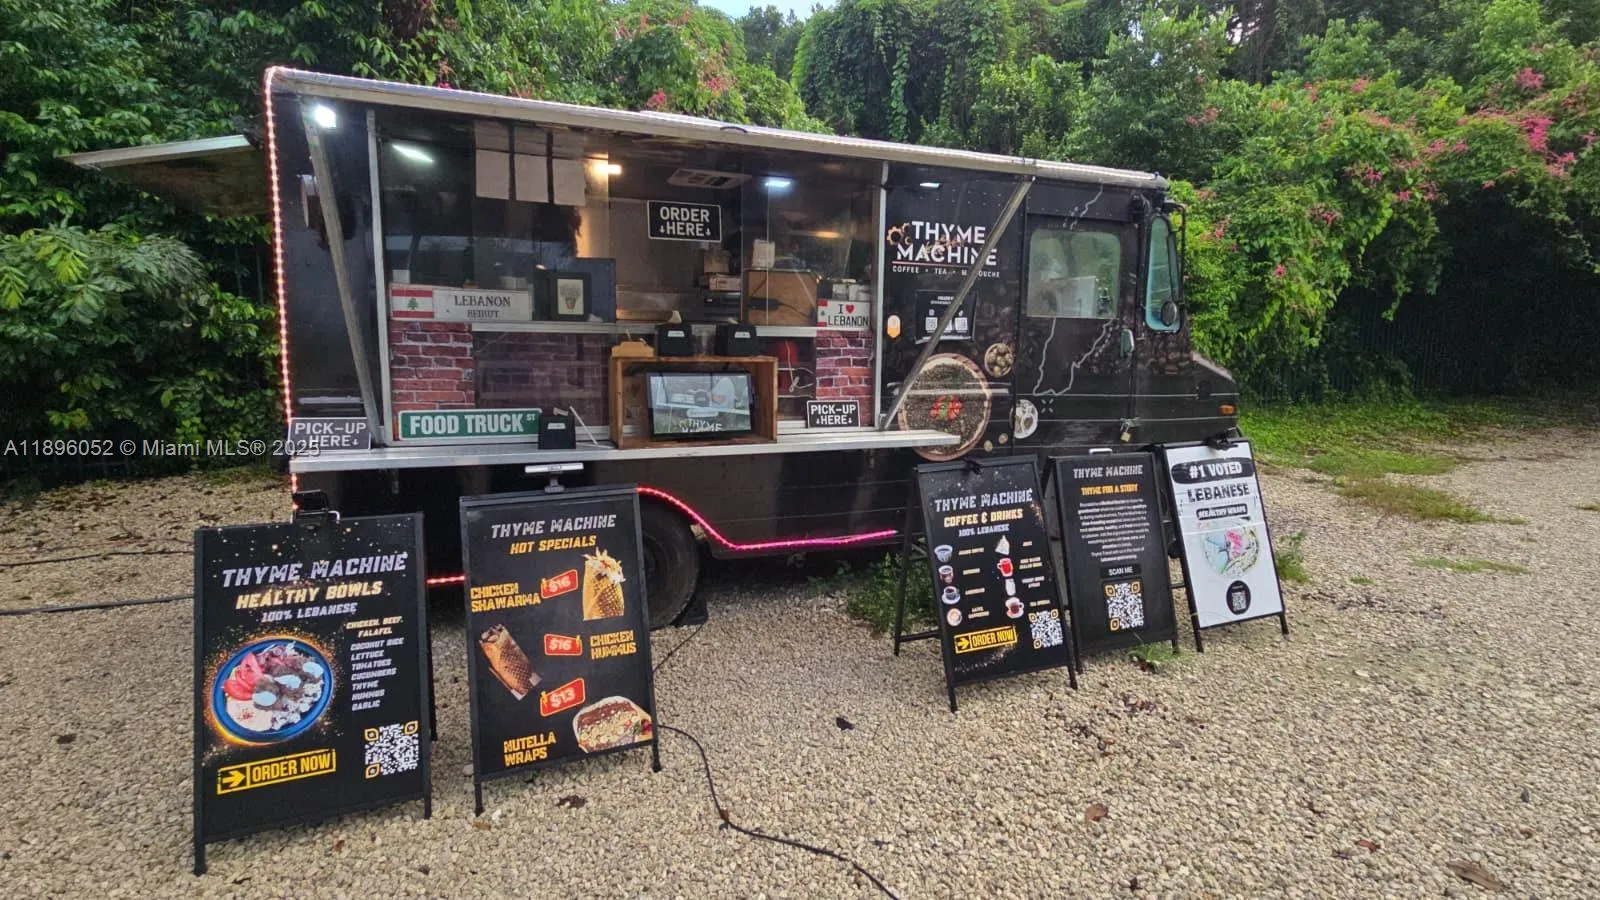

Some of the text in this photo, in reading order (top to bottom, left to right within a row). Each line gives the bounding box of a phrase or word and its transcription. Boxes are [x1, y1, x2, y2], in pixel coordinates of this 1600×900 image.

[660, 206, 710, 223] ORDER
[666, 220, 705, 236] HERE
[911, 221, 986, 244] THYME
[896, 243, 998, 266] MACHINE
[892, 265, 919, 274] COFFEE
[961, 270, 1000, 278] MOUCHE
[454, 294, 511, 307] LEBANON
[838, 303, 844, 314] I
[467, 309, 500, 319] BEIRUT
[828, 315, 869, 327] LEBANON
[810, 403, 857, 415] PICK-UP
[409, 412, 537, 436] FOOD TRUCK ST
[820, 414, 848, 425] HERE
[294, 422, 367, 435] PICK-UP
[308, 434, 352, 449] HERE
[1073, 464, 1144, 479] THYME MACHINE
[1189, 461, 1243, 479] #1 VOTED
[1114, 485, 1120, 493] A
[1187, 483, 1251, 503] LEBANESE
[934, 488, 1033, 512] THYME MACHINE
[943, 508, 1024, 528] COFFEE & DRINKS
[491, 514, 617, 539] THYME MACHINE
[977, 523, 1010, 535] LEBANESE
[510, 535, 597, 555] HOT SPECIALS
[222, 553, 408, 588] THYME MACHINE
[470, 582, 519, 600] CHICKEN
[549, 576, 571, 593] $16
[235, 580, 384, 609] HEALTHY BOWLS
[471, 593, 541, 613] SHAWARMA
[260, 602, 359, 623] 100% LEBANESE
[357, 626, 393, 638] FALAFEL
[589, 630, 634, 646] CHICKEN
[971, 628, 1014, 647] ORDER NOW
[350, 640, 385, 651] COCONUT
[549, 638, 572, 651] $16
[590, 642, 637, 660] HUMMUS
[350, 649, 385, 661] LETTUCE
[351, 658, 393, 671] TOMATOES
[351, 667, 397, 681] CUCUMBERS
[351, 680, 380, 691] THYME
[351, 689, 385, 701] HUMMUS
[550, 687, 576, 708] $13
[351, 699, 381, 711] GARLIC
[503, 731, 557, 753] NUTELLA
[504, 746, 548, 768] WRAPS
[252, 752, 332, 783] ORDER NOW
